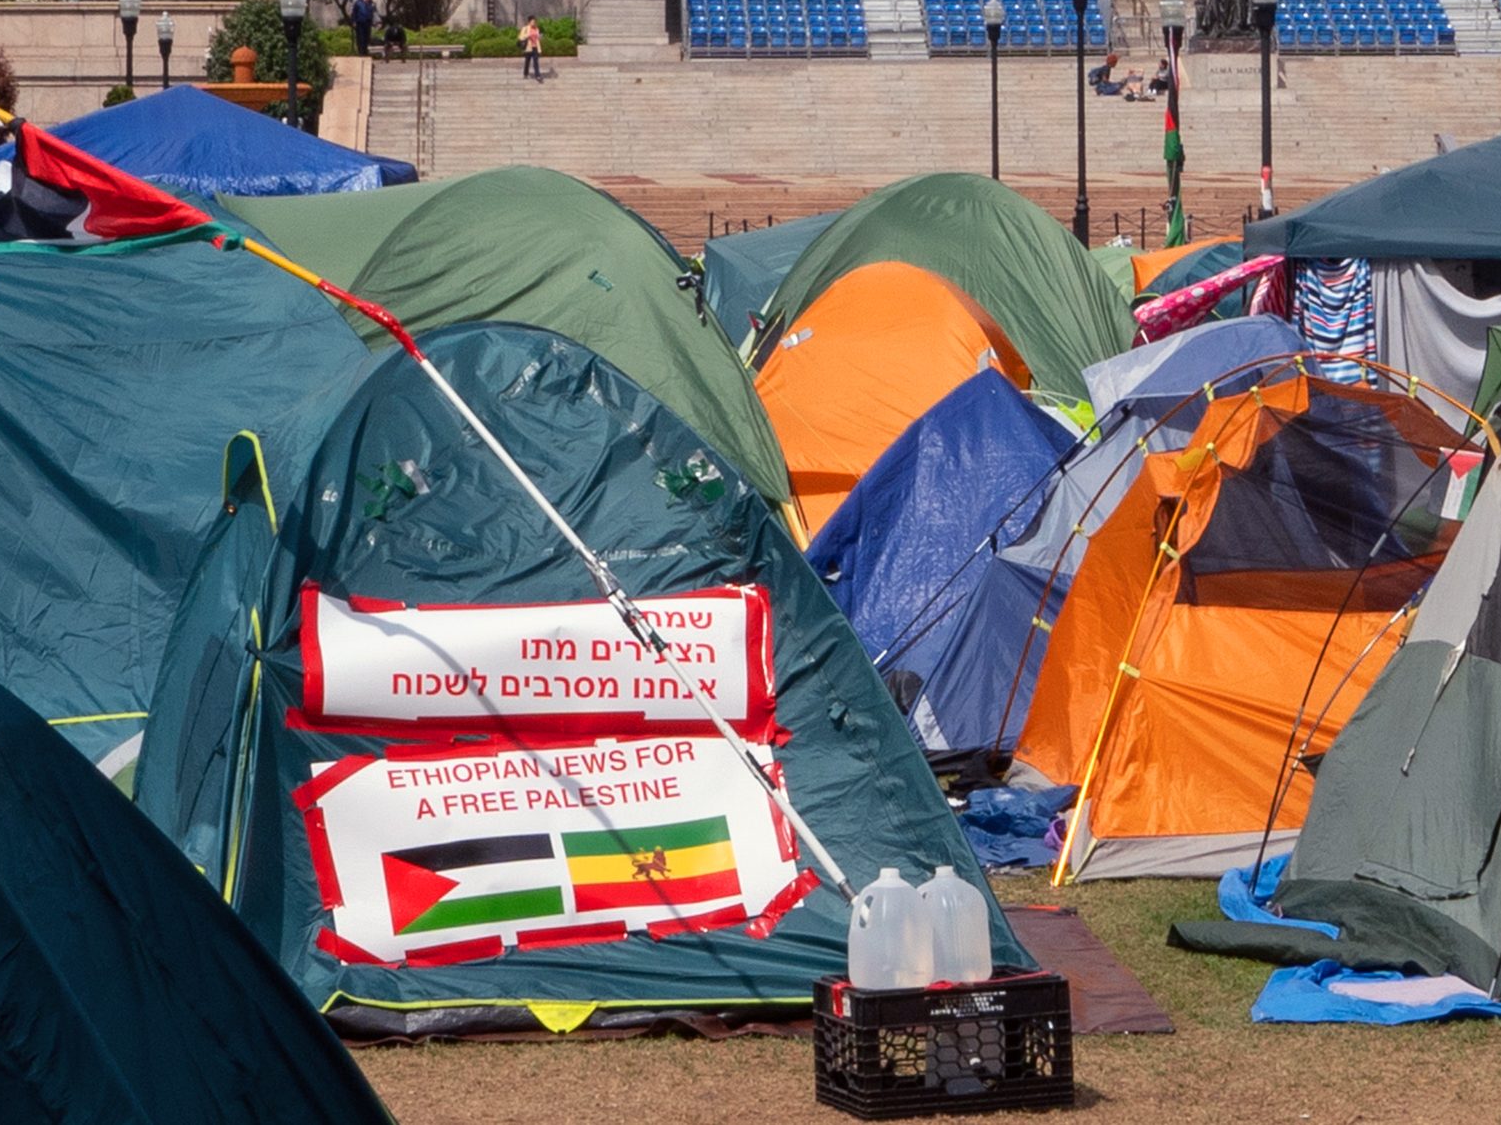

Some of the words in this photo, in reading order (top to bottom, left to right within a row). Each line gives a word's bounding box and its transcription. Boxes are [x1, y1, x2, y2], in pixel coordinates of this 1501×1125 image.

[521, 638, 577, 661] מתו
[391, 667, 487, 696] לשכוח
[501, 676, 619, 699] מסרבים
[387, 757, 540, 789] ETHIOPIAN
[548, 749, 628, 778] JEWS
[635, 741, 696, 768] FOR
[416, 798, 436, 820] A
[443, 791, 518, 816] FREE
[526, 777, 681, 809] PALESTINE
